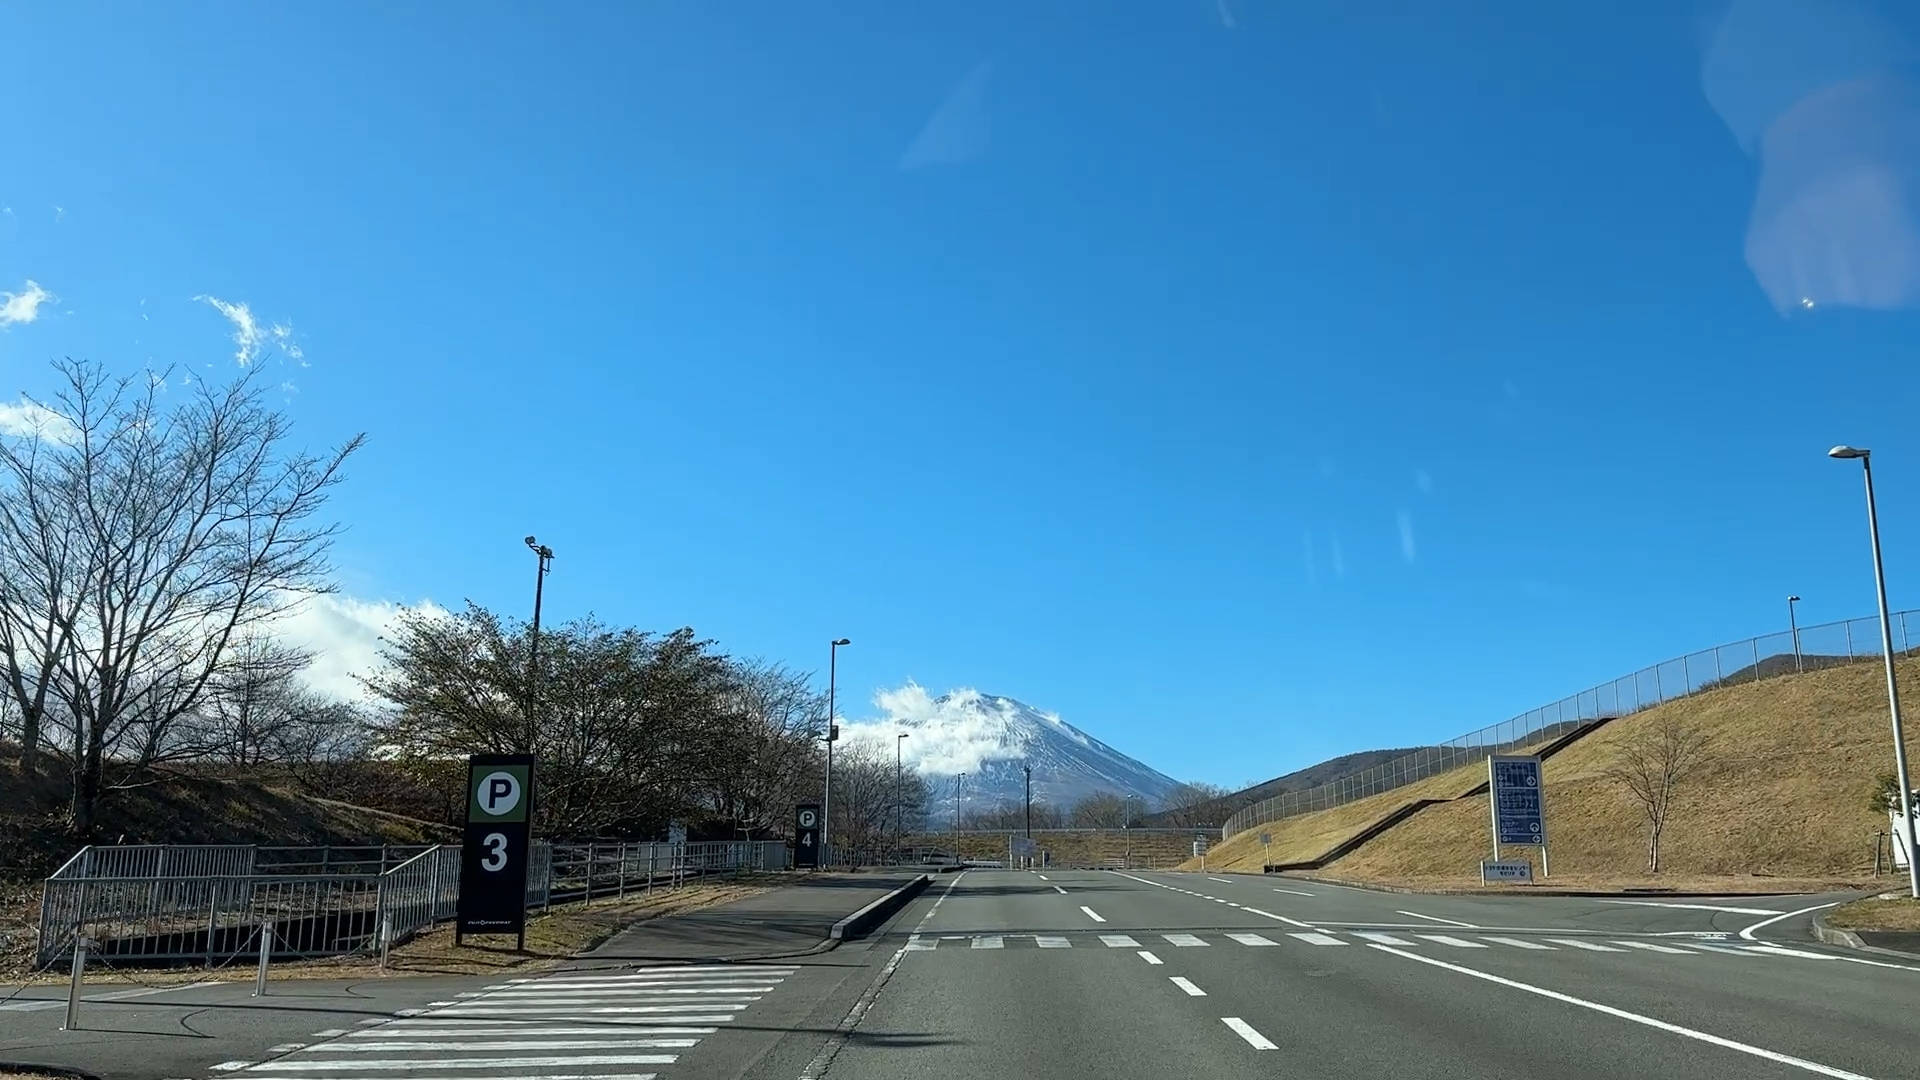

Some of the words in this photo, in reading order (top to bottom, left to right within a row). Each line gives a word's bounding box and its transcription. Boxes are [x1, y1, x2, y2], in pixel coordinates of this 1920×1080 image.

[488, 779, 512, 809] P
[803, 812, 813, 825] P
[802, 832, 812, 847] 4
[481, 833, 508, 872] 3
